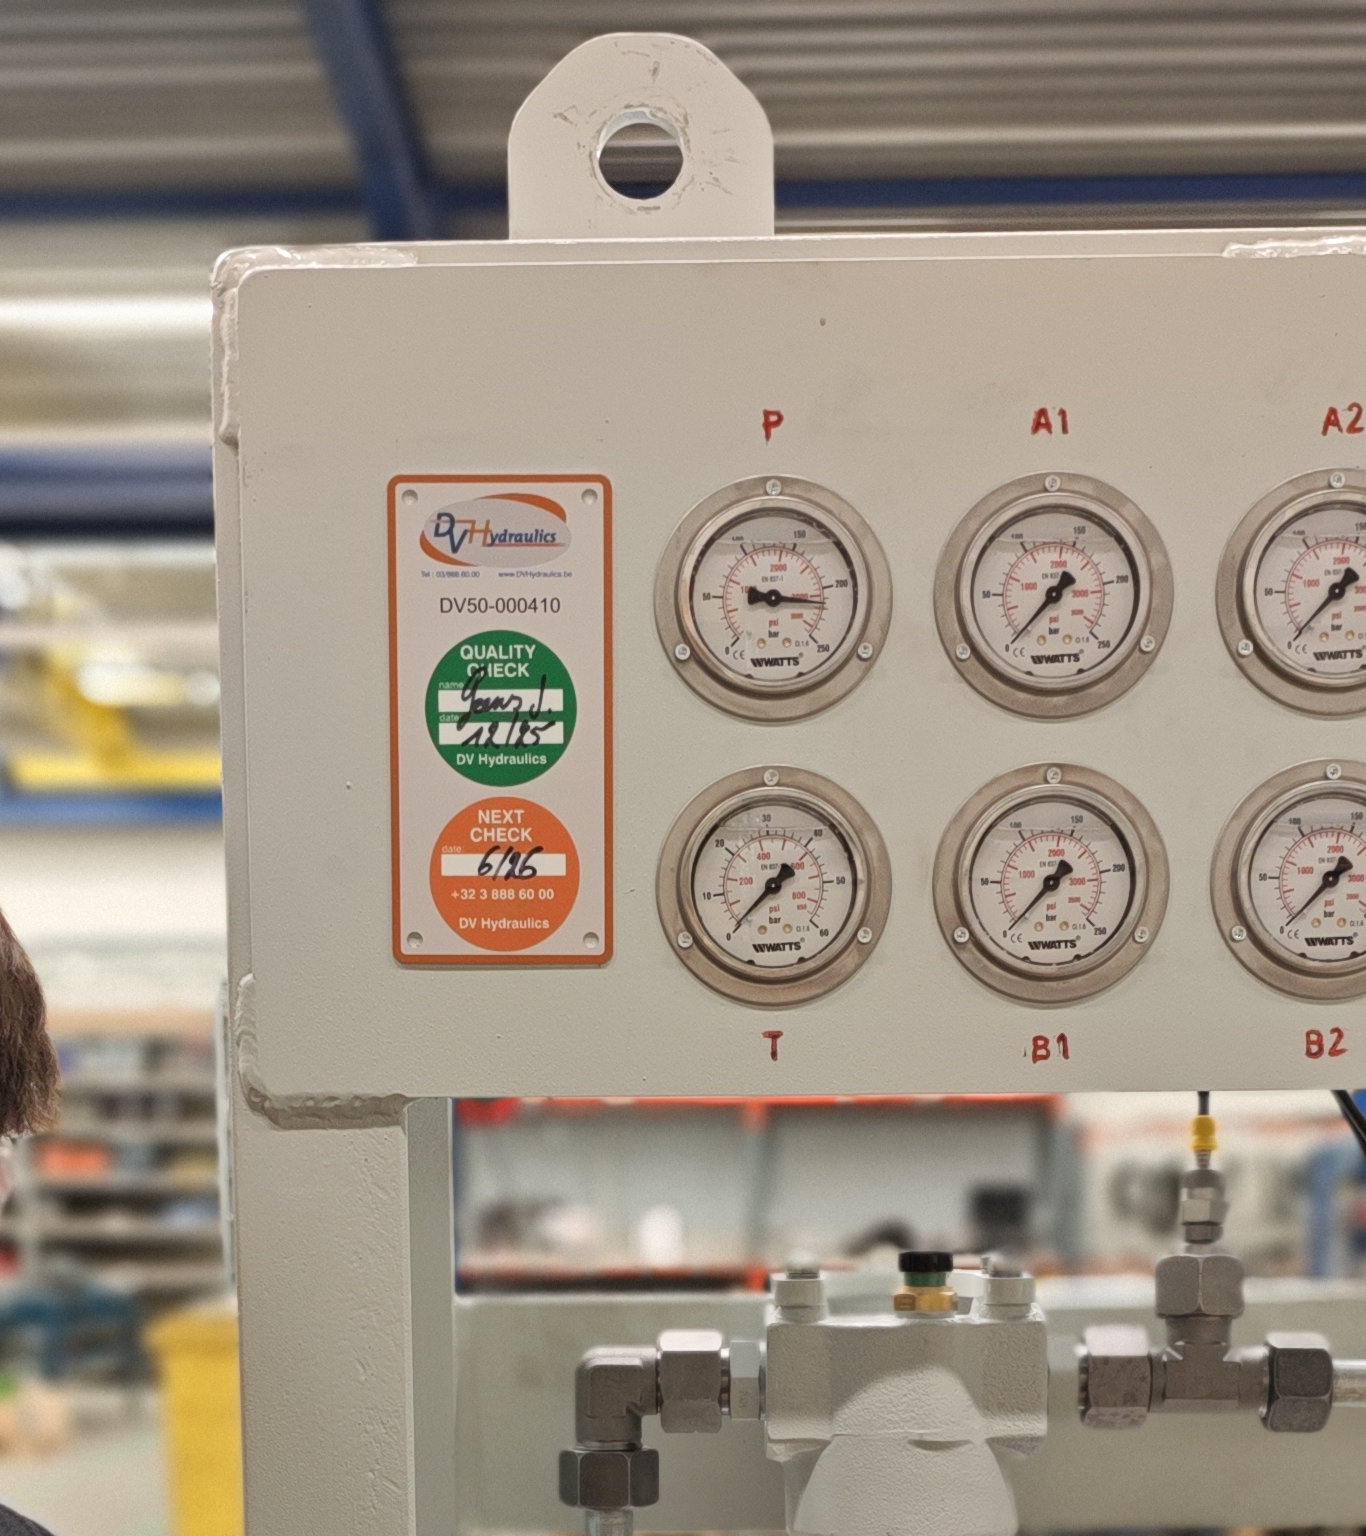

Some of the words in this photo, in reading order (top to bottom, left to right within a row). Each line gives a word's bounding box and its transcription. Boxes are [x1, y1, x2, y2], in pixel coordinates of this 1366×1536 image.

[1031, 408, 1068, 435] A1
[1321, 402, 1364, 436] A2
[762, 409, 783, 443] P
[439, 597, 561, 613] DV50-000410
[1049, 626, 1059, 635] bar
[1331, 623, 1342, 632] bar
[768, 630, 779, 639] bar
[460, 644, 537, 660] QUALITY
[1314, 649, 1363, 660] WATTS
[751, 657, 799, 667] WATTS
[1031, 653, 1080, 664] WATTS
[466, 663, 530, 678] CHECK
[456, 753, 474, 765] DV
[478, 753, 547, 768] Hydraulics
[477, 809, 525, 824] NEXT
[762, 814, 771, 822] 30
[470, 827, 533, 842] CHECK
[715, 839, 724, 847] 20
[757, 852, 770, 861] 400
[477, 845, 544, 881] 6/26
[739, 877, 753, 885] 200
[836, 876, 845, 885] 50
[451, 888, 476, 900] +32
[480, 888, 487, 900] 3
[491, 888, 515, 900] 888
[519, 888, 535, 900] 60
[538, 888, 554, 900] 00
[703, 892, 711, 900] 10
[792, 891, 805, 900] 800
[769, 904, 780, 914] psi
[1324, 910, 1334, 918] bar
[769, 916, 781, 925] bar
[1046, 913, 1057, 922] bar
[459, 917, 477, 929] DV
[481, 917, 550, 932] Hydraulics
[820, 929, 829, 937] 60
[1028, 940, 1076, 950] WATTS
[1305, 936, 1354, 946] WATTS
[753, 941, 801, 953] WATTS
[761, 1030, 783, 1061] T
[1305, 1027, 1348, 1059] B2
[1031, 1033, 1069, 1064] B1
